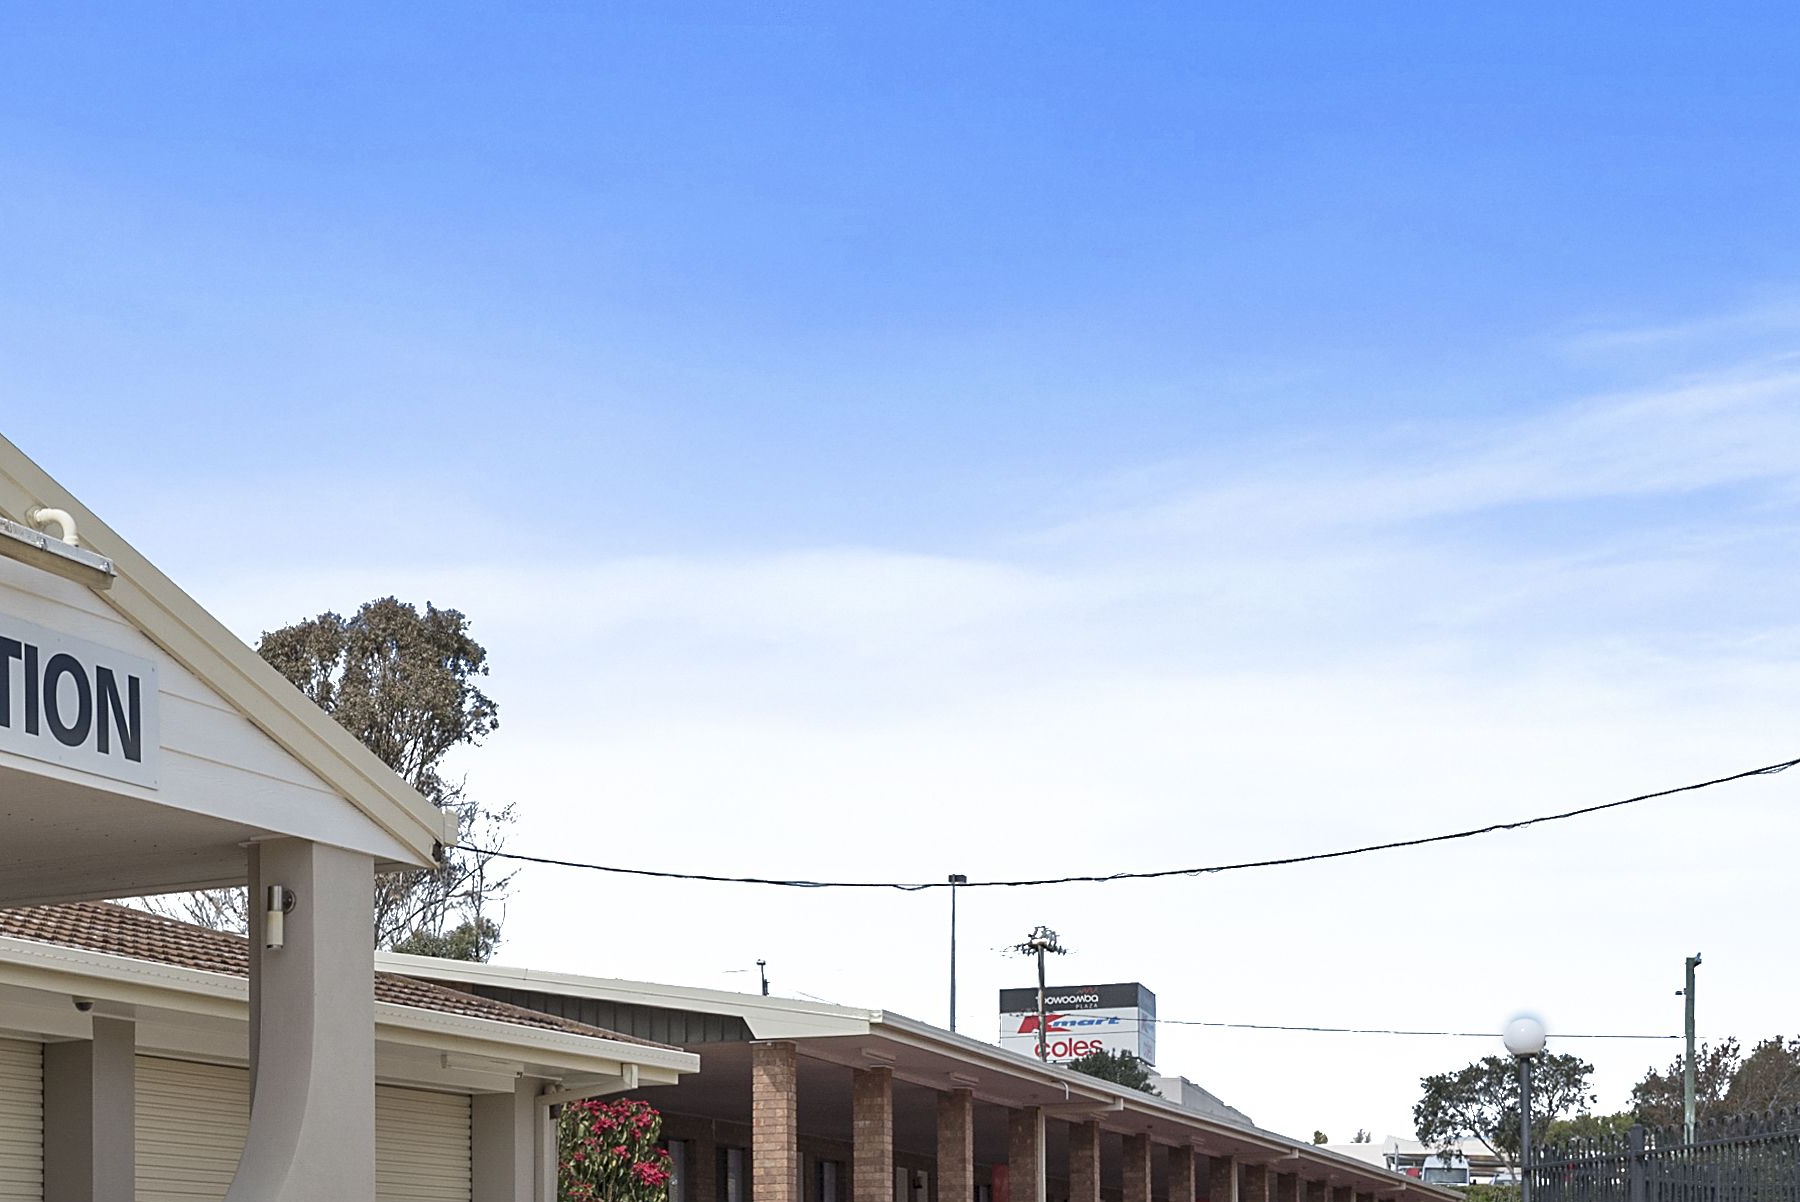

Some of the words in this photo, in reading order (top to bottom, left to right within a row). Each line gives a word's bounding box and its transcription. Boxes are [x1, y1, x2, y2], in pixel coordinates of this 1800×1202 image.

[1035, 993, 1099, 1005] owoomba
[1017, 1014, 1120, 1034] Kmart
[1034, 1037, 1103, 1058] coles
